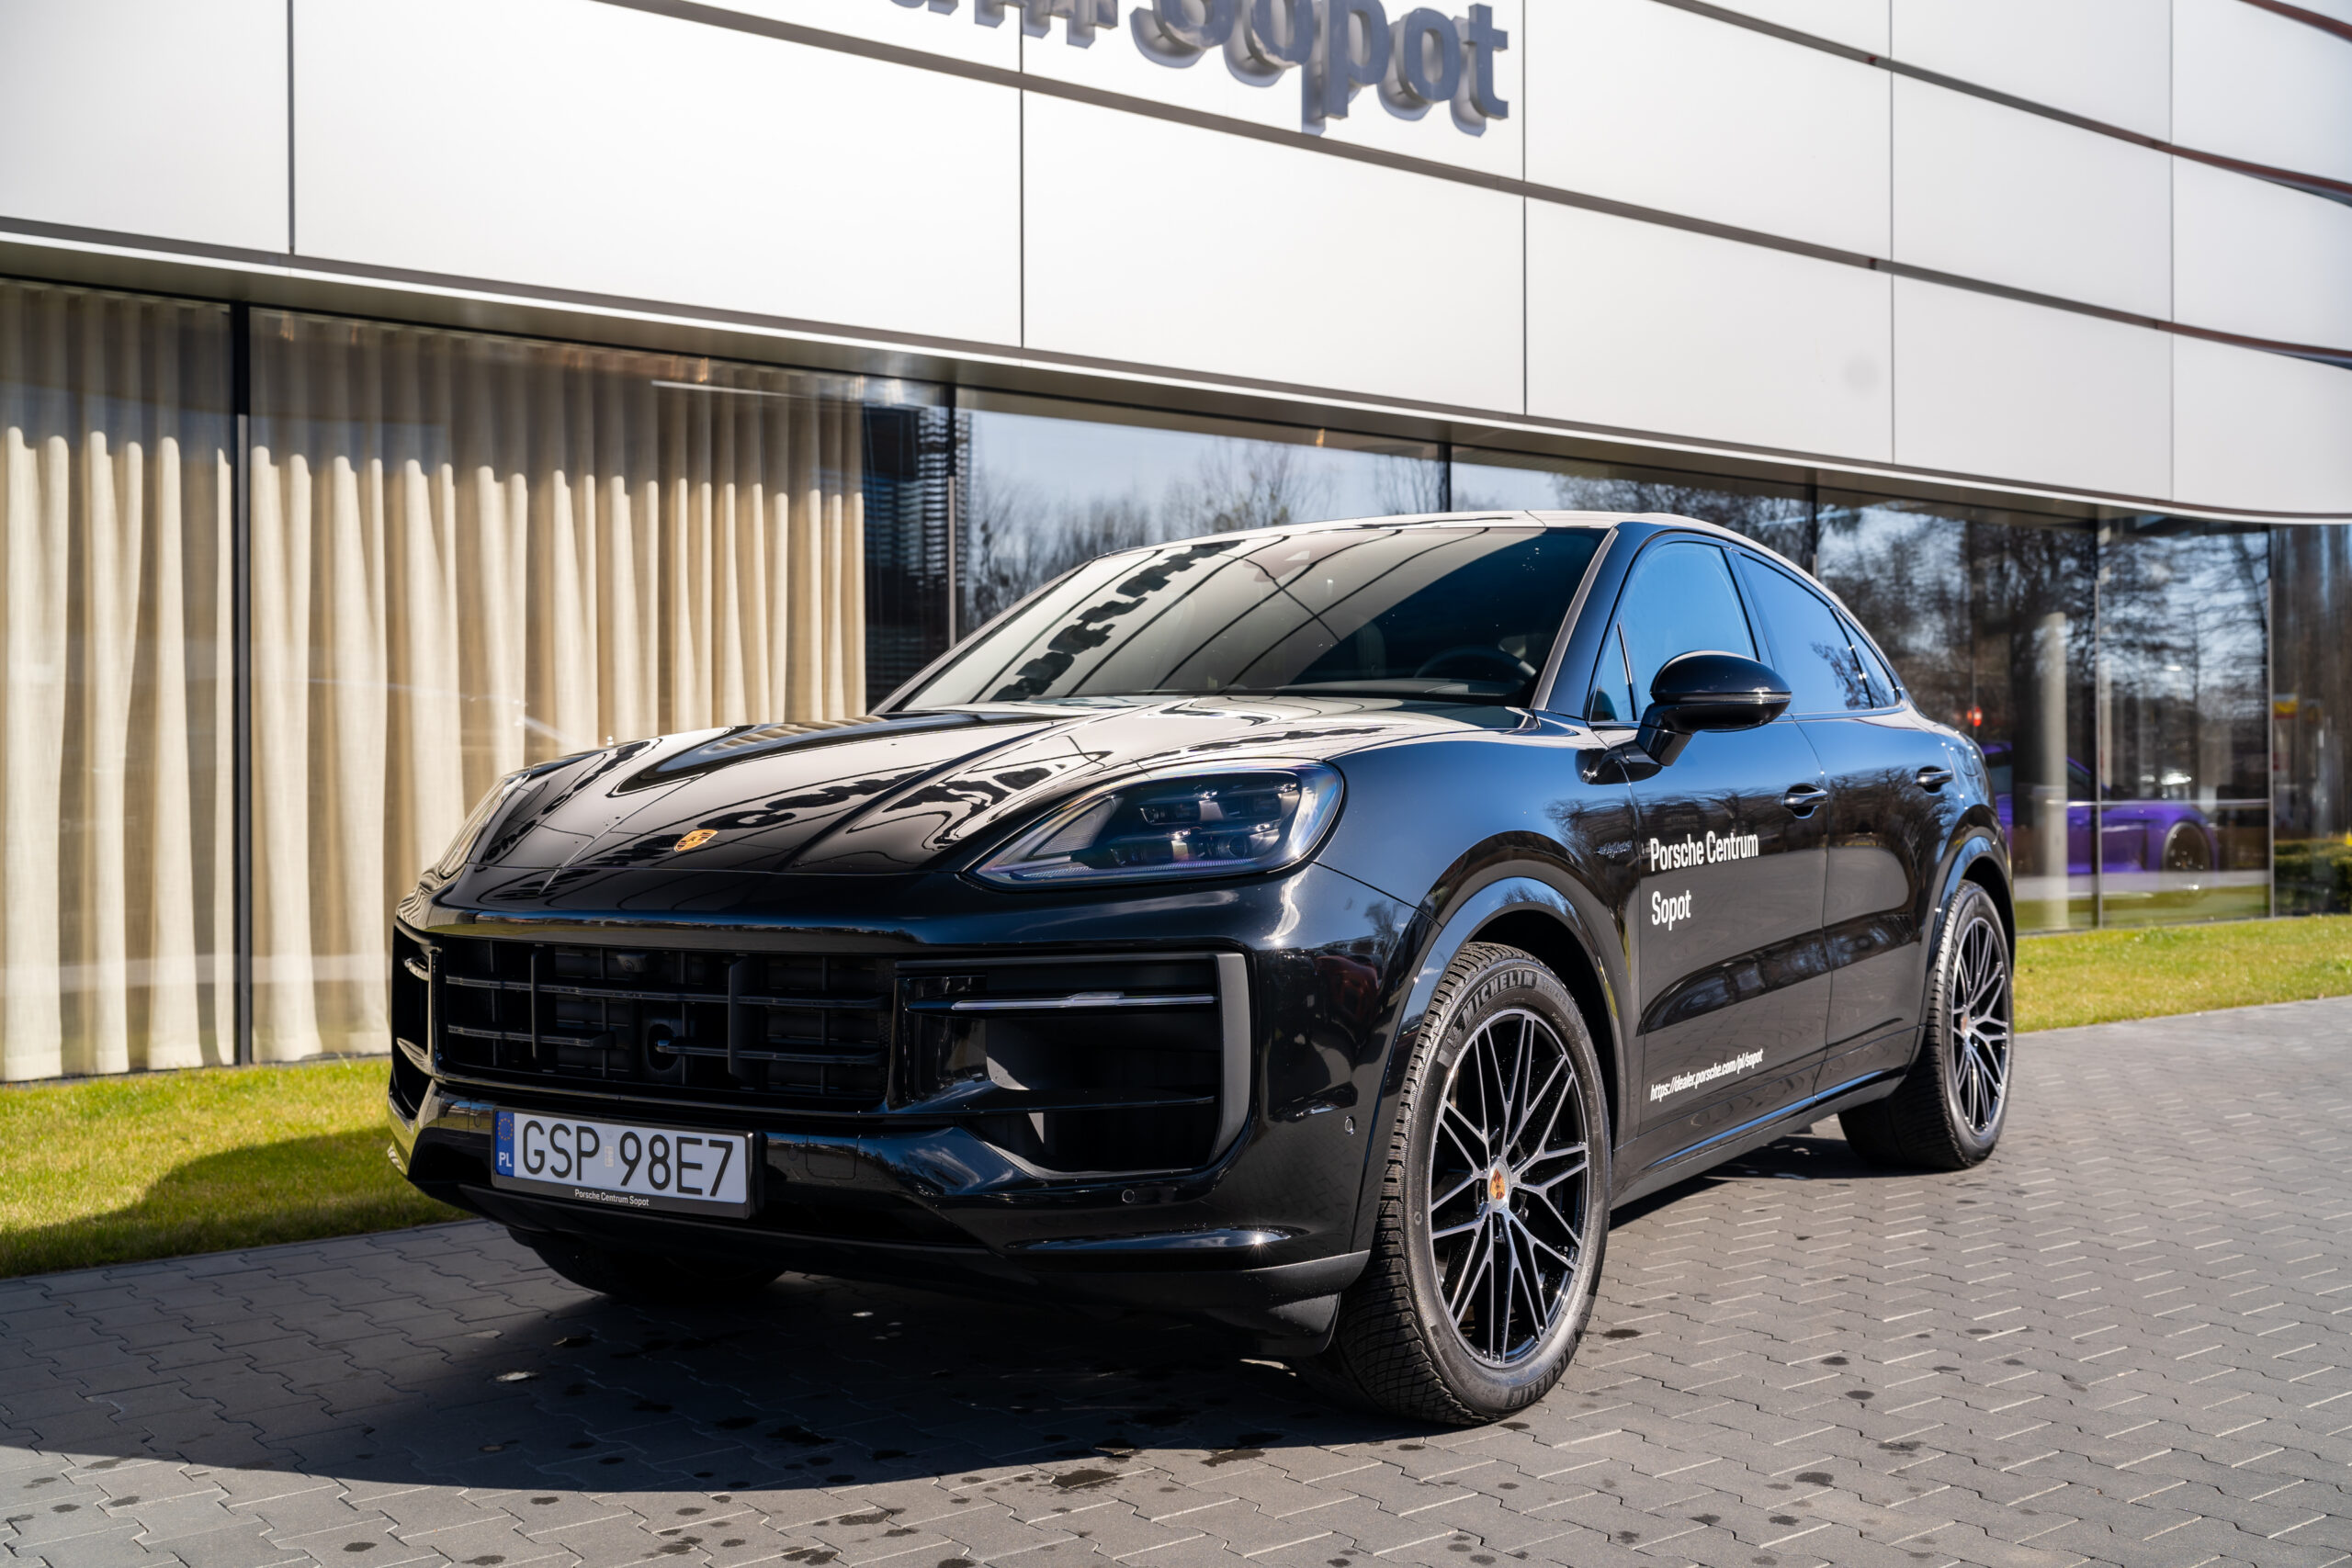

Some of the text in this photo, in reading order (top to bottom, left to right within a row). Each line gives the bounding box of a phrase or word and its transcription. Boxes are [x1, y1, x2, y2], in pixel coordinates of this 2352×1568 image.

[1650, 833, 1704, 873] Porsche
[1706, 830, 1759, 863] Centrum
[1651, 889, 1691, 931] Sopot
[1462, 969, 1533, 1027] MICHELIN
[498, 1151, 513, 1168] PL
[523, 1120, 733, 1197] GSP 98E7
[574, 1189, 650, 1206] Porsche Centrum Sopot
